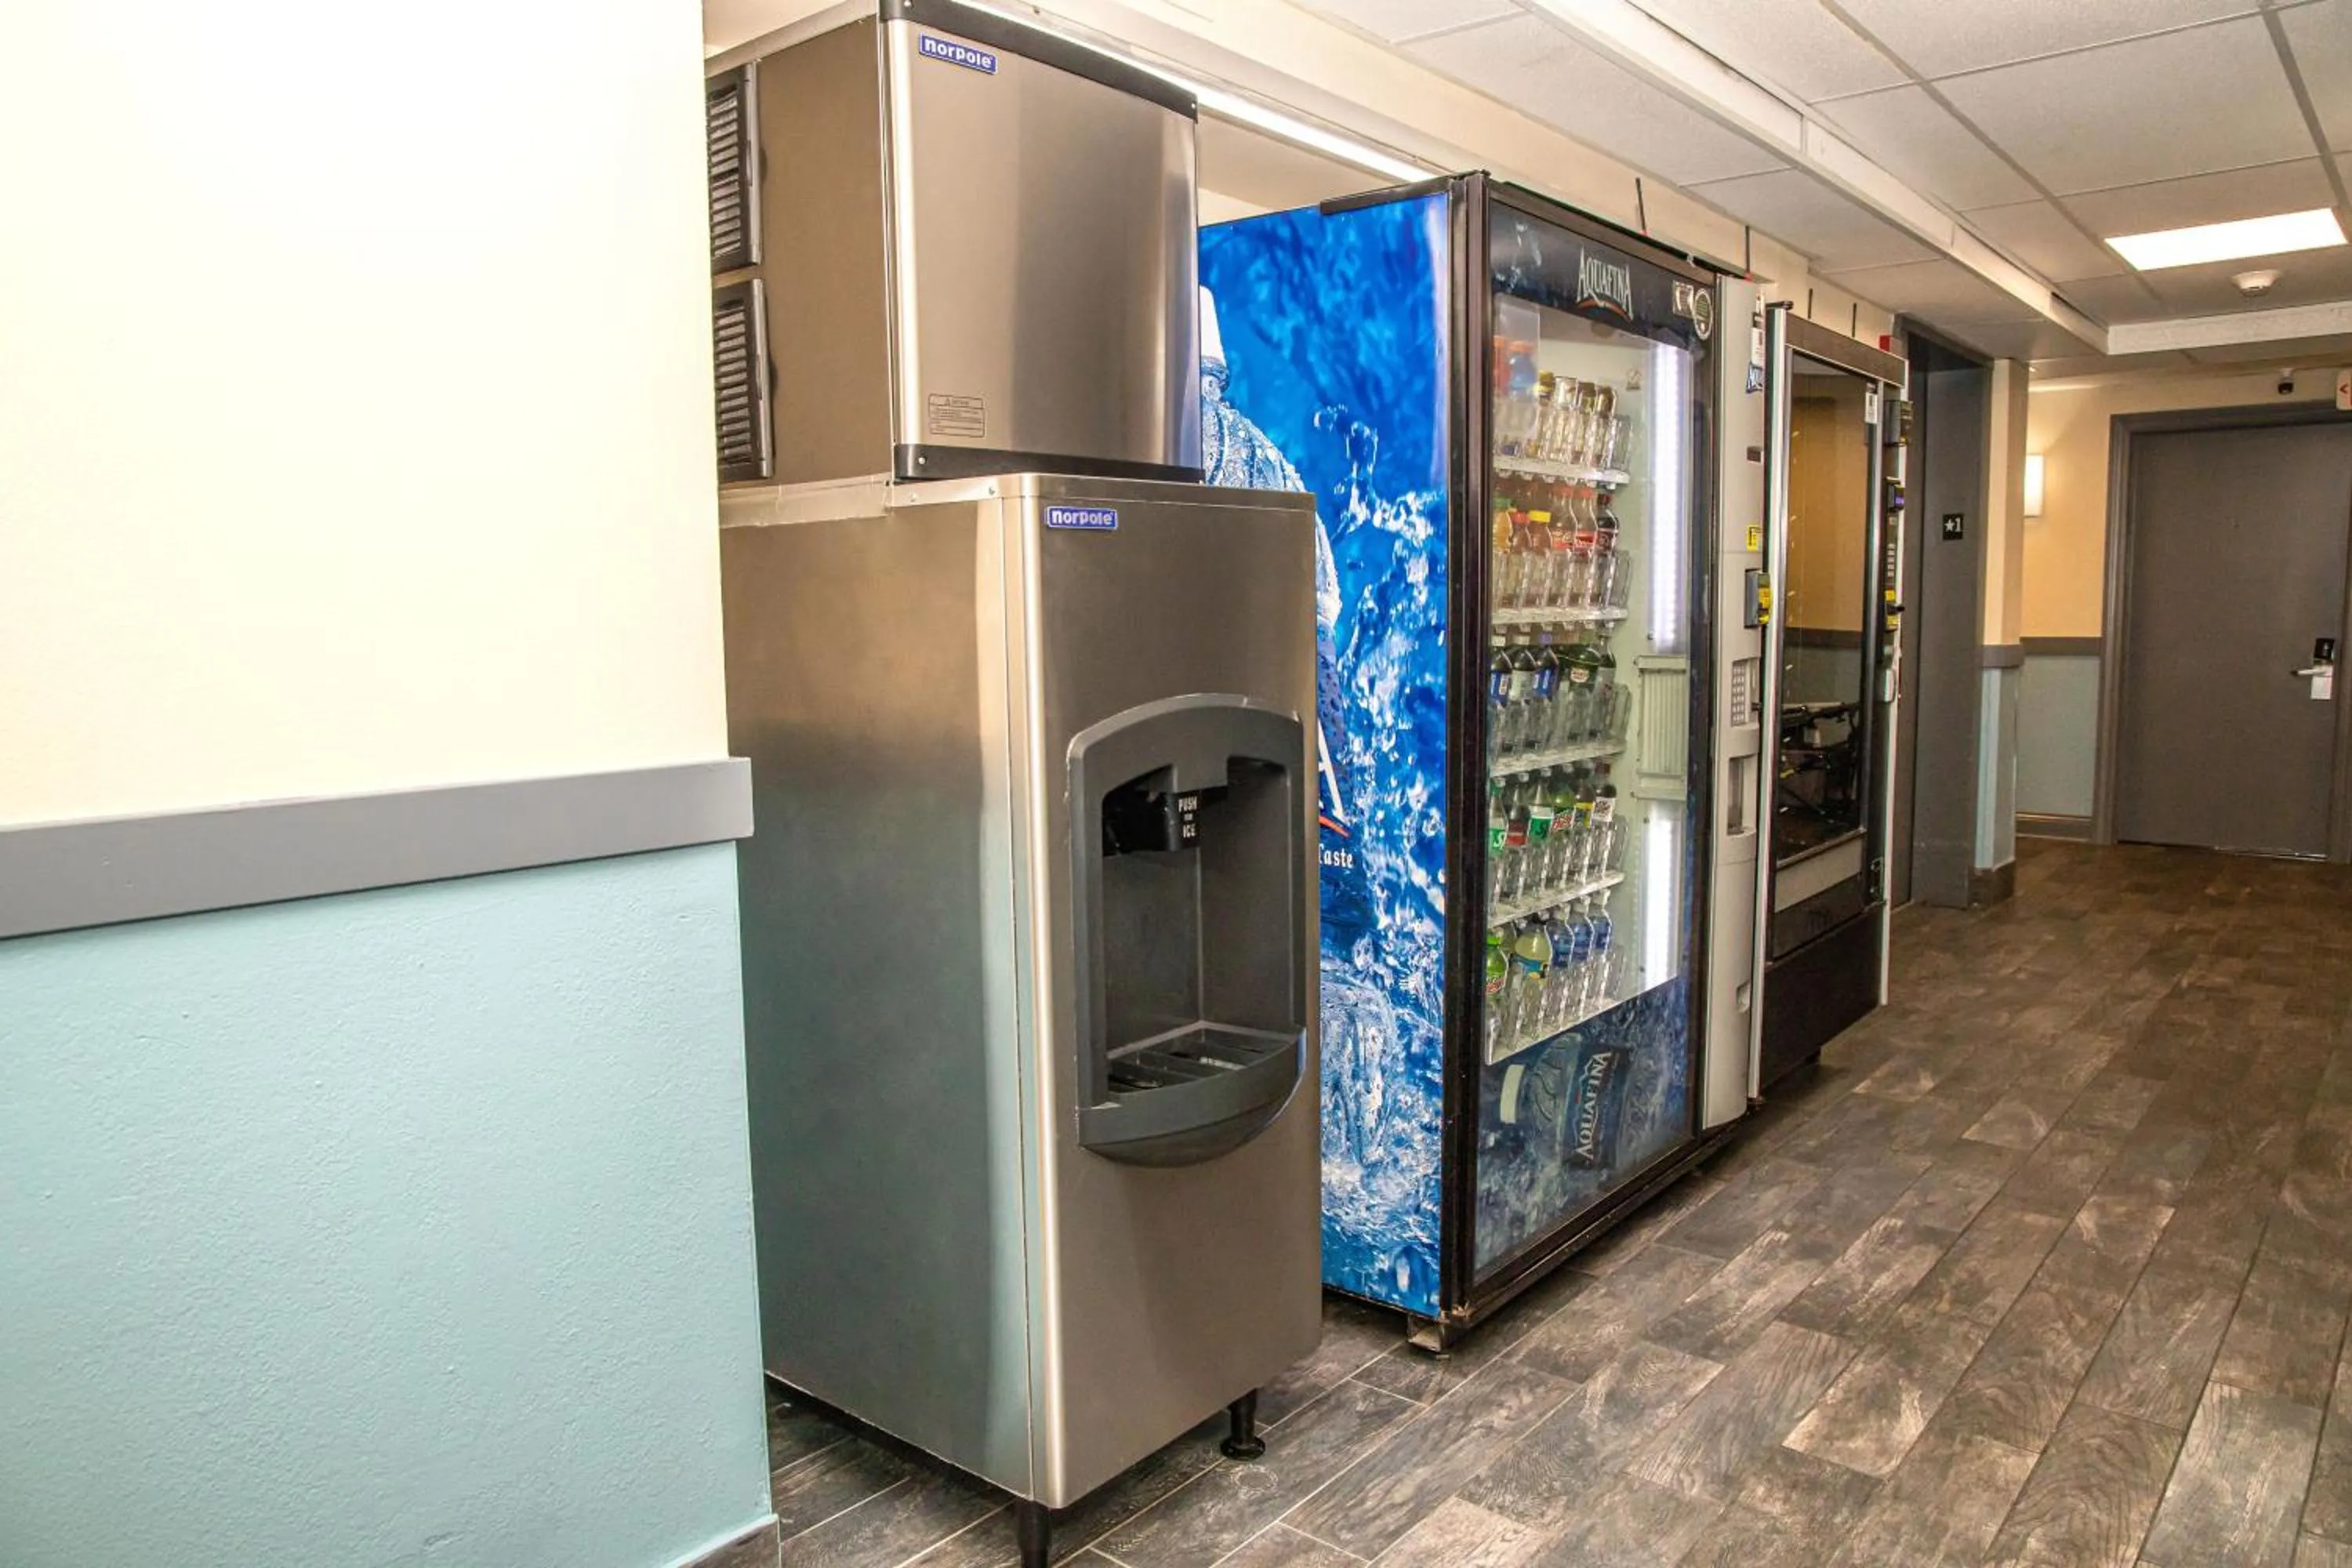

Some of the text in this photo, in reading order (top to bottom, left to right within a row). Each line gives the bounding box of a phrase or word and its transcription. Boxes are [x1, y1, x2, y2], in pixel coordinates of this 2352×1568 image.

[925, 38, 993, 69] norpole
[1577, 246, 1634, 321] AQUAFINA
[1051, 510, 1113, 525] norpole
[1575, 1051, 1612, 1160] AQUAFINA
